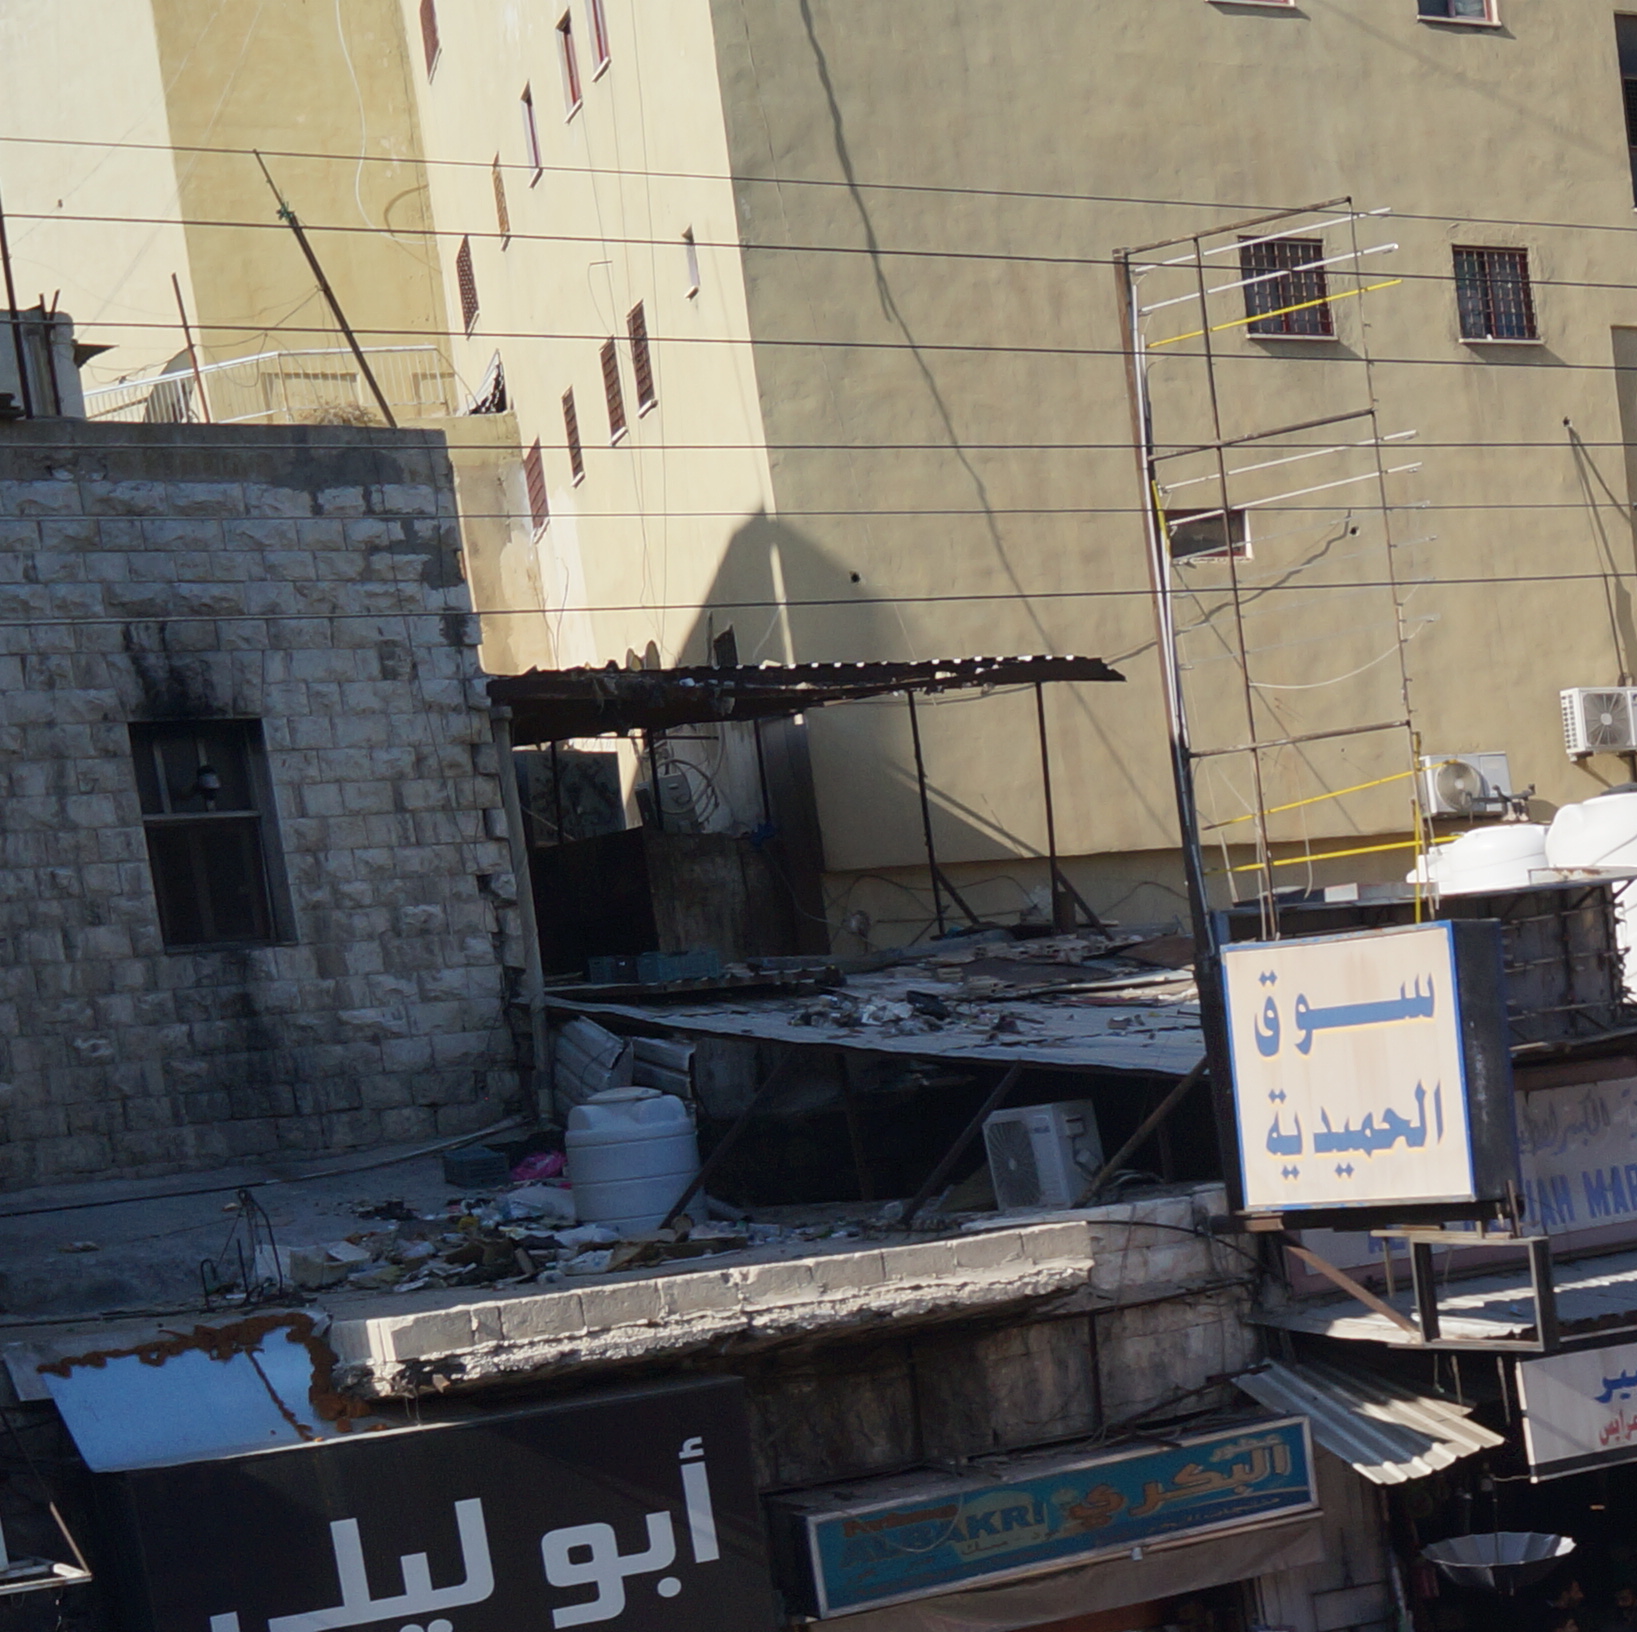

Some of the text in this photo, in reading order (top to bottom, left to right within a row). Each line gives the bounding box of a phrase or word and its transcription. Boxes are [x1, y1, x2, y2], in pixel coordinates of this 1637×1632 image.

[1255, 971, 1436, 1059] سوق
[1266, 1080, 1444, 1180] الحميدية
[1069, 1444, 1292, 1527] البكري
[541, 1436, 720, 1630] أبو
